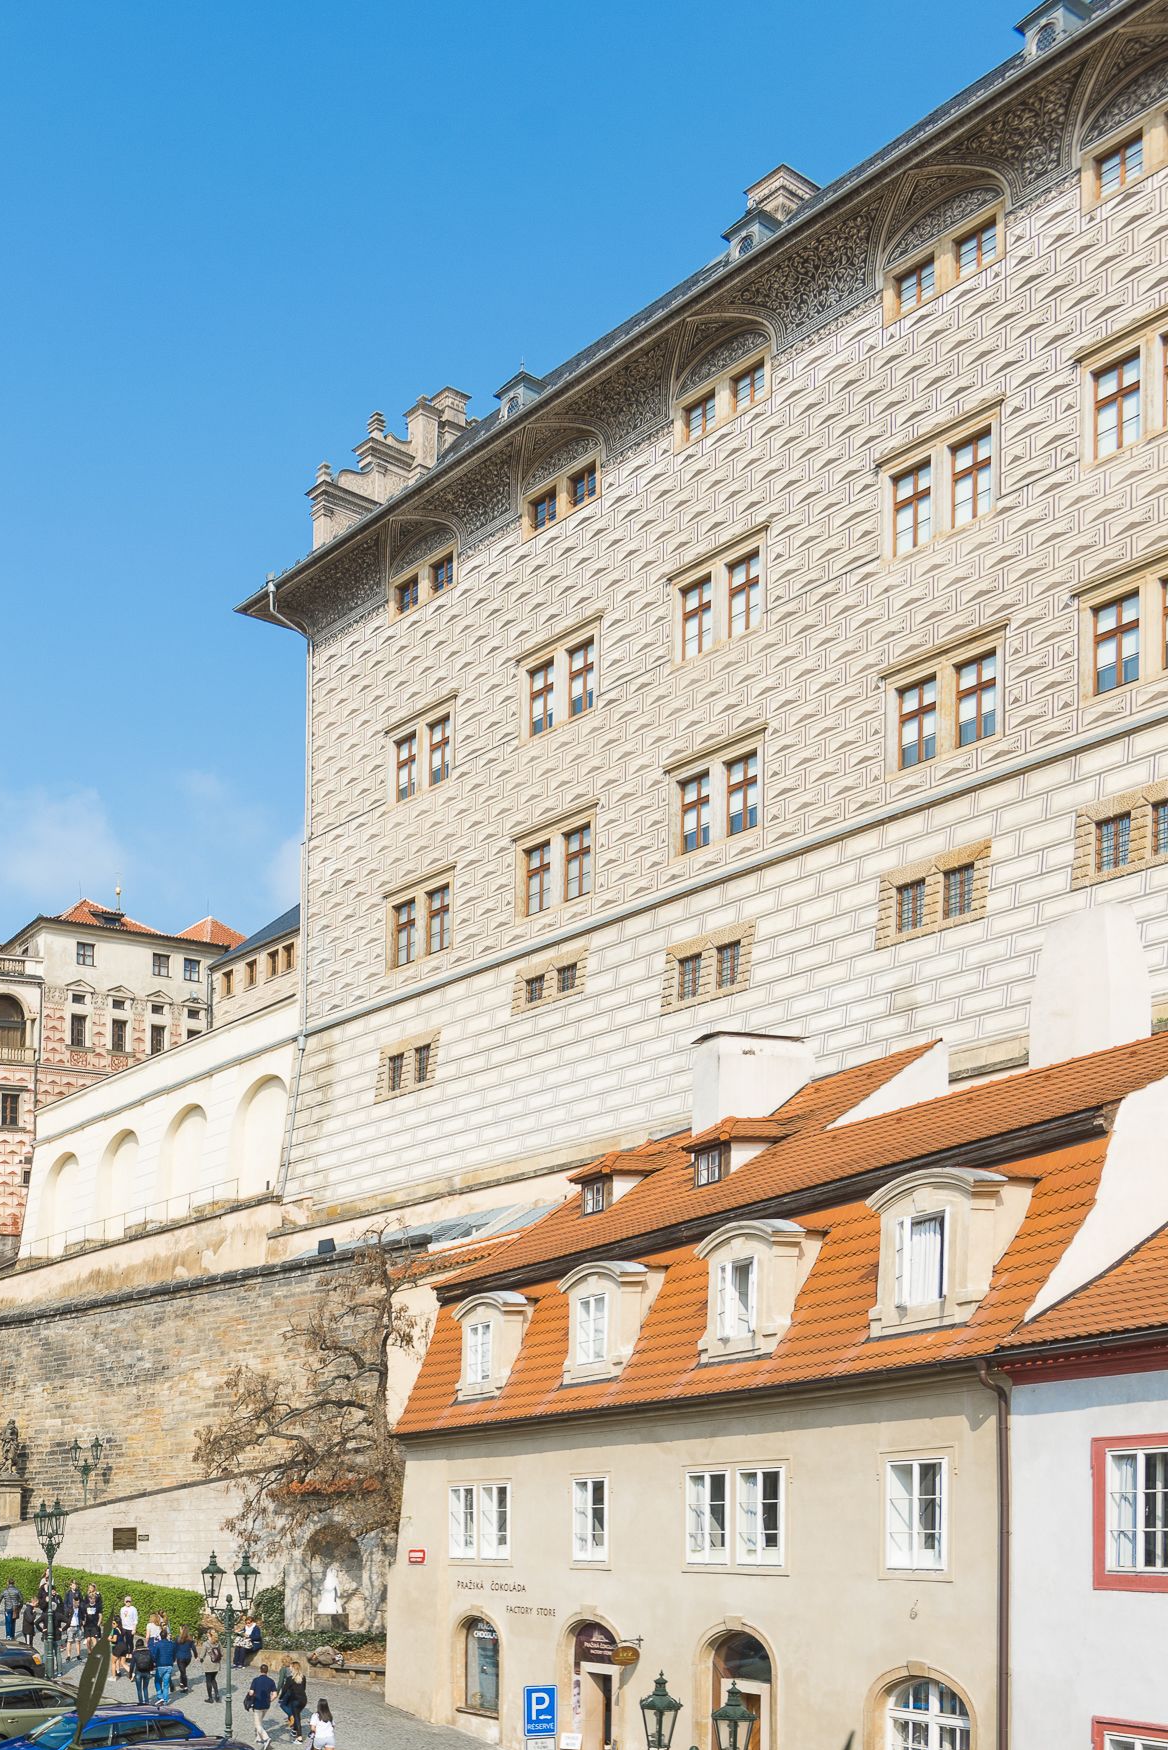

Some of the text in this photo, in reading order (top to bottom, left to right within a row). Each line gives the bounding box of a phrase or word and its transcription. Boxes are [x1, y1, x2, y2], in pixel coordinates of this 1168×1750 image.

[456, 1579, 527, 1592] PRAŽSKÁ ČOKOLÁDA
[505, 1605, 556, 1617] FACTORY STORE
[531, 1692, 550, 1720] P
